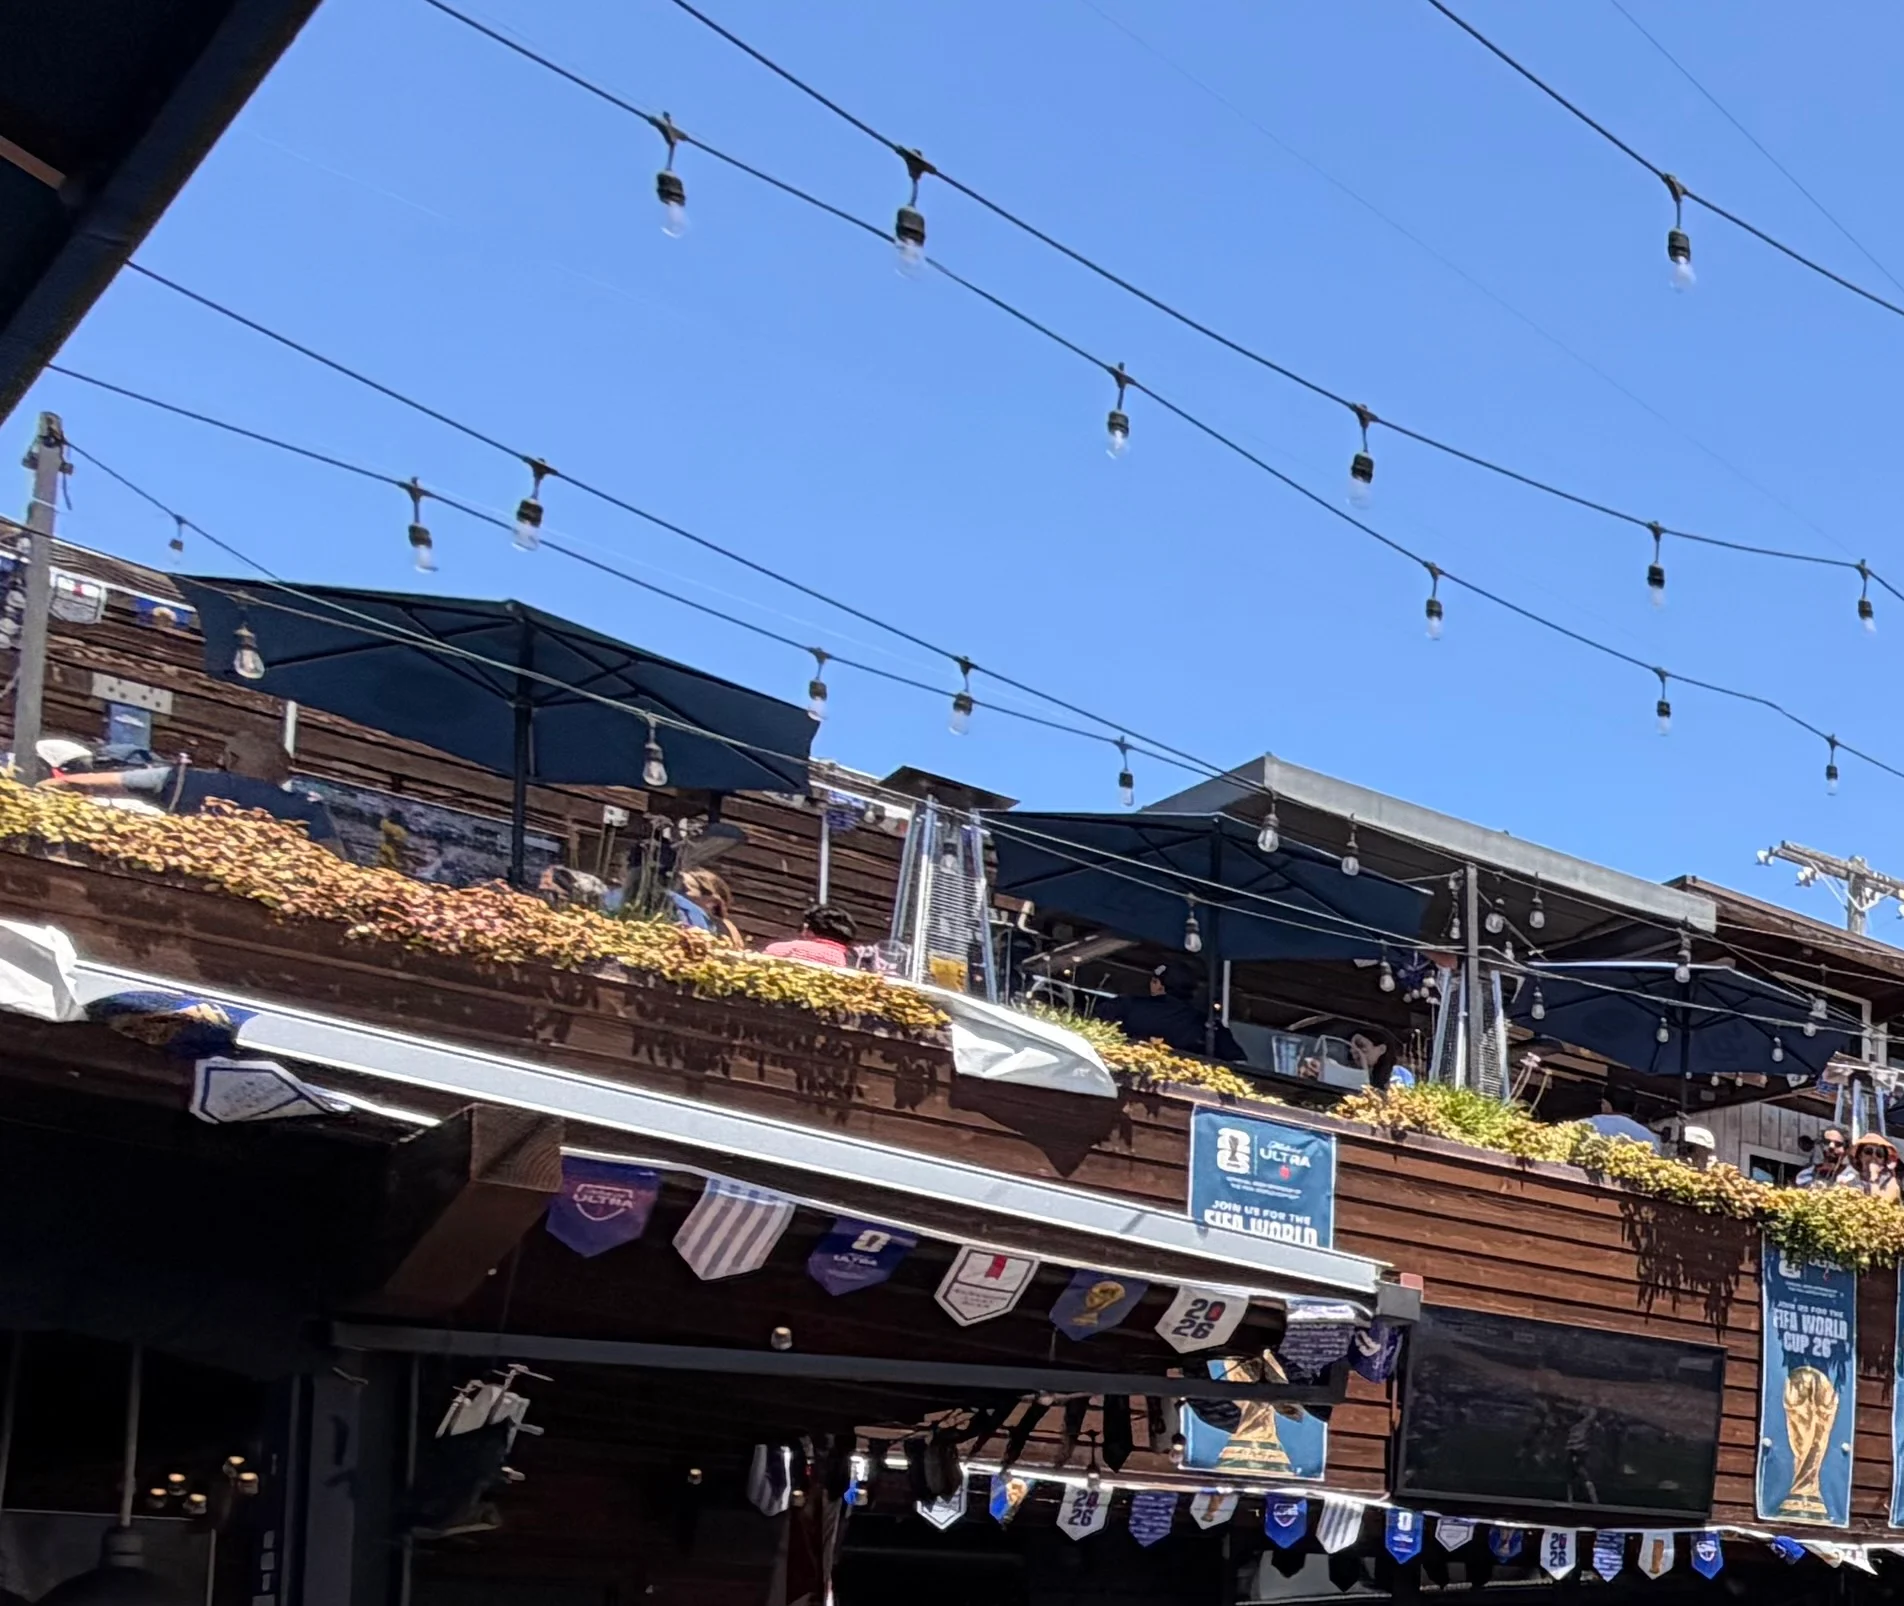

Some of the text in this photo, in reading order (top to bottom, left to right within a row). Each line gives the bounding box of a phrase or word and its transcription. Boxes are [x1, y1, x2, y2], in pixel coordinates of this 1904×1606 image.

[1260, 1148, 1311, 1168] ULTRA
[1212, 1200, 1241, 1213] JOIN
[1263, 1208, 1287, 1220] FOR
[1184, 1298, 1226, 1321] 20
[1171, 1319, 1215, 1340] 26
[1773, 1307, 1848, 1340] FIFA WORLD
[1783, 1330, 1810, 1353] CUP
